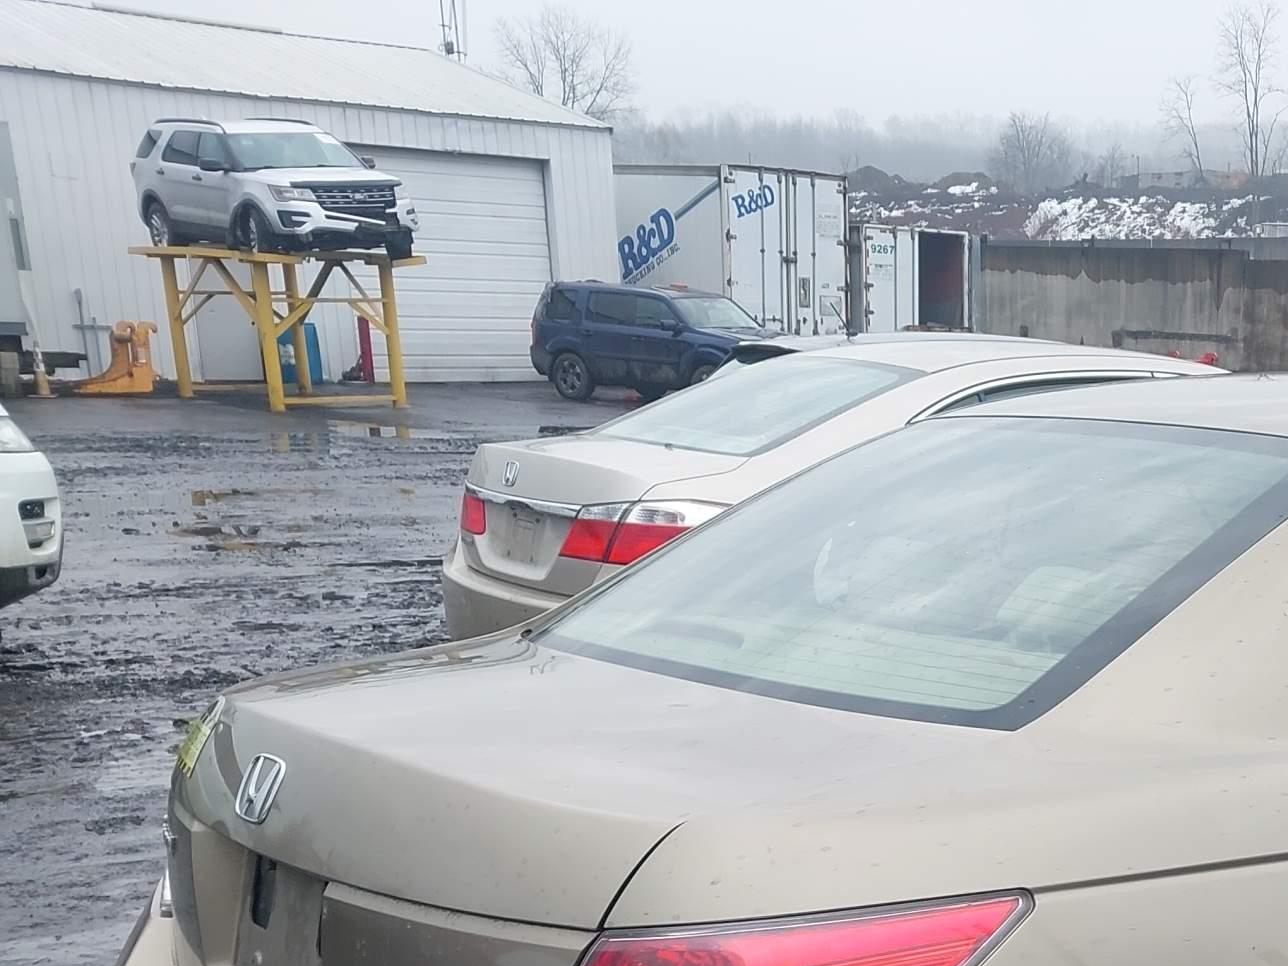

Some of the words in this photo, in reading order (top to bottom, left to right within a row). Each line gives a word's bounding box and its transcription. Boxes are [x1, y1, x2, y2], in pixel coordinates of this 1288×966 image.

[731, 184, 775, 218] R&D
[618, 208, 675, 281] R&D
[871, 243, 895, 255] 9267
